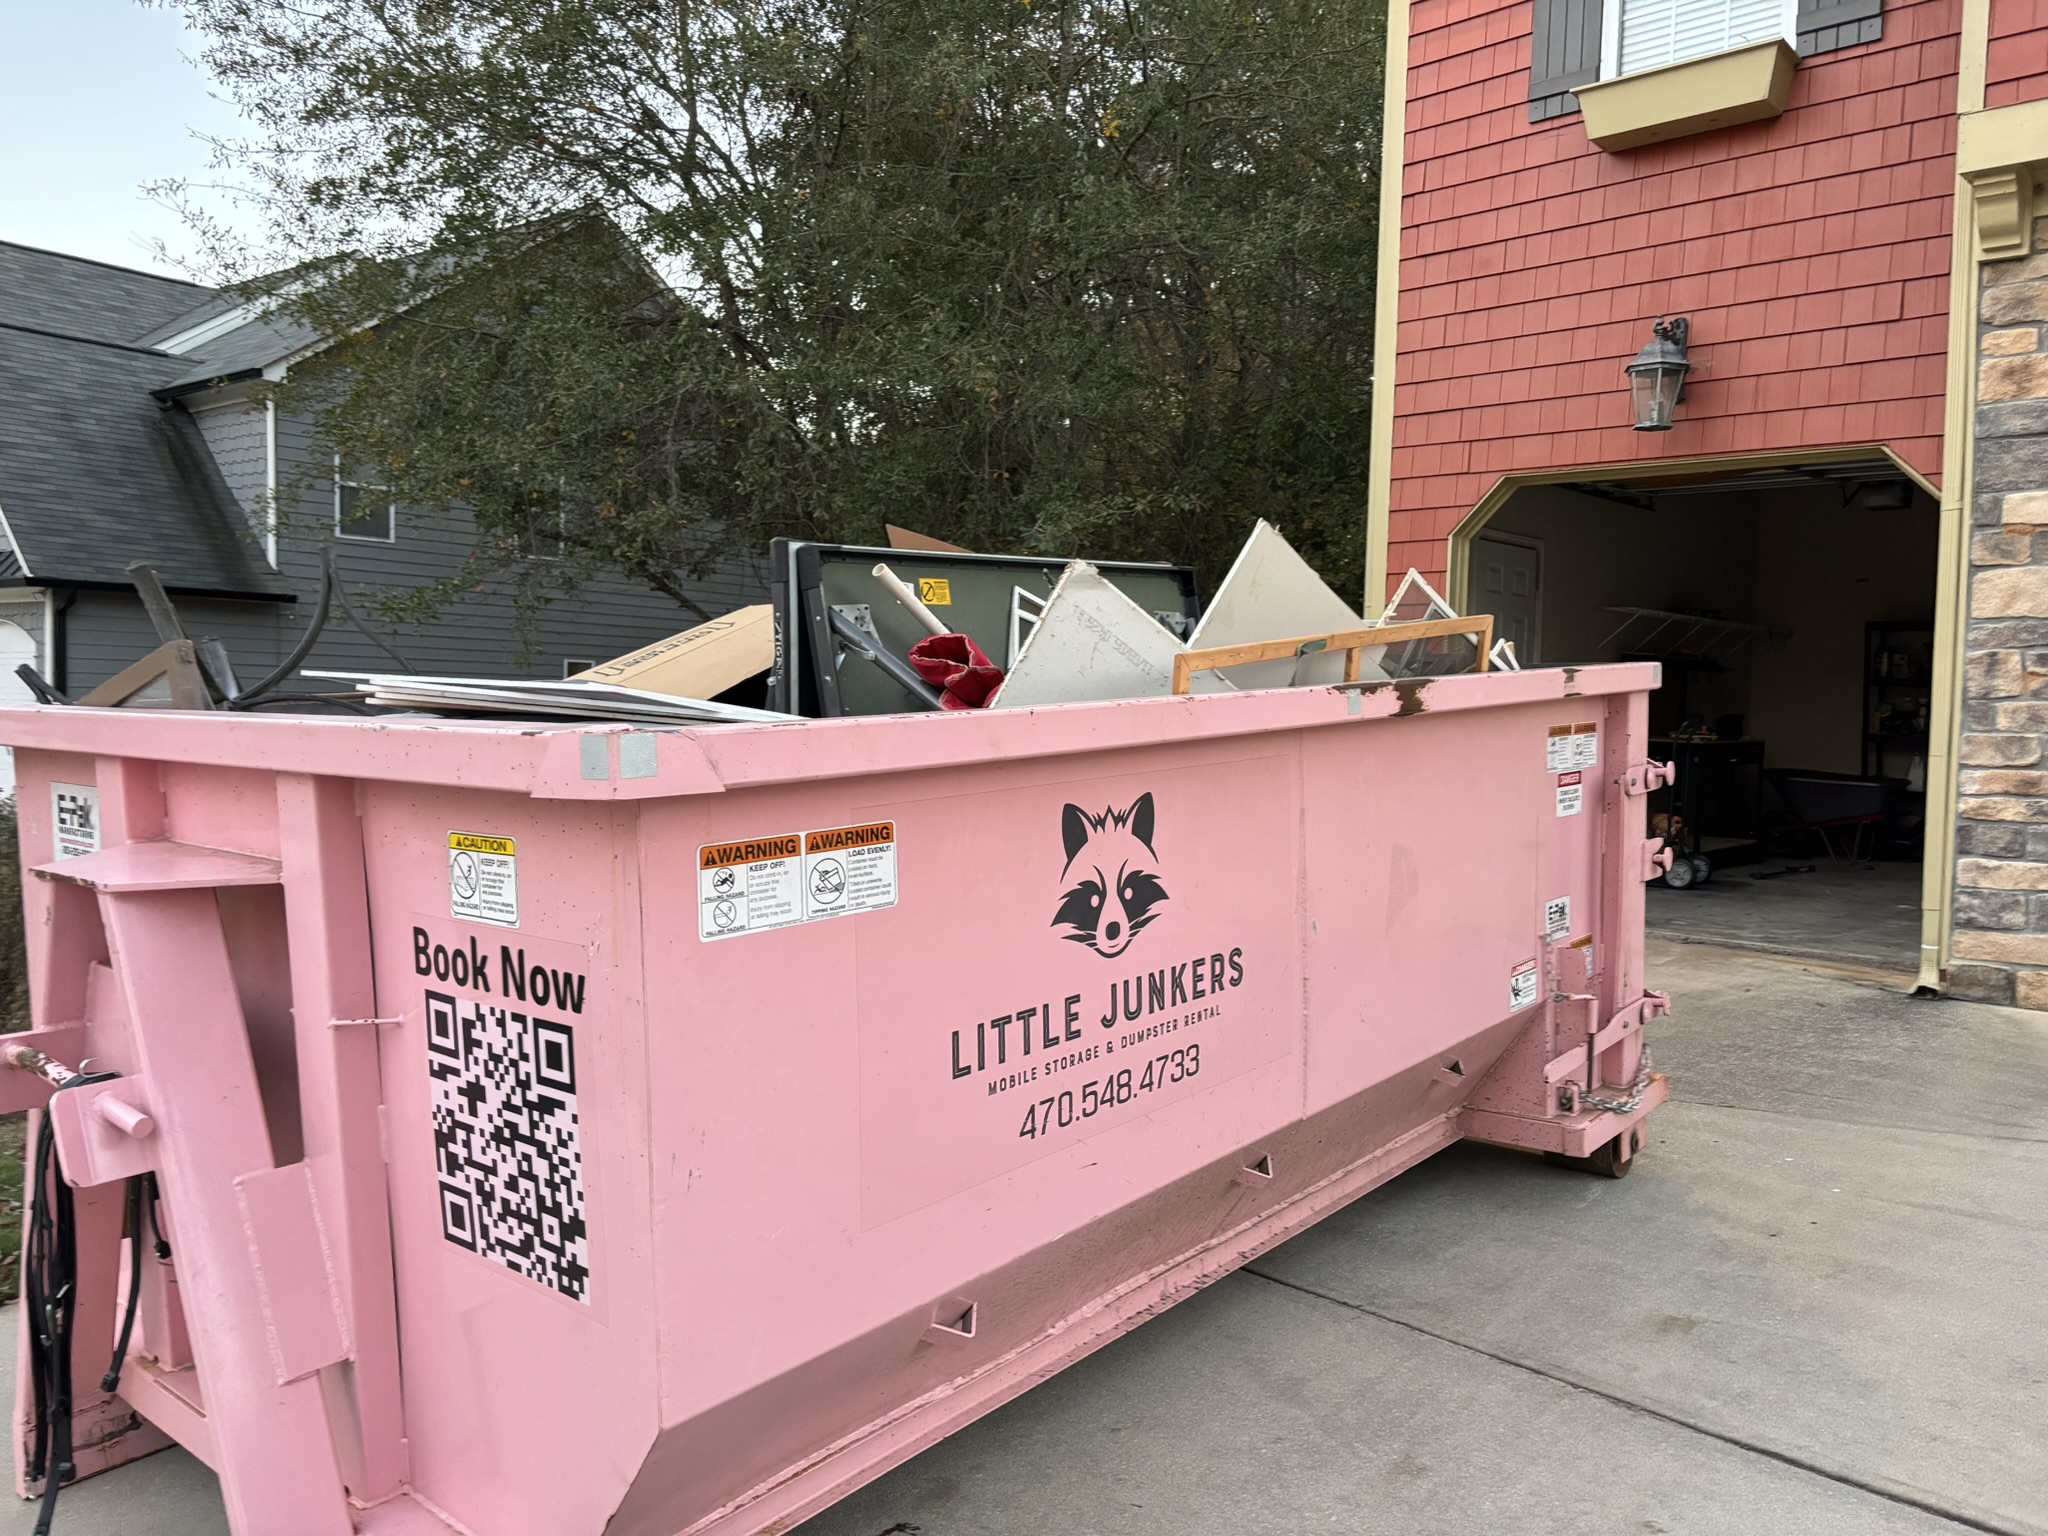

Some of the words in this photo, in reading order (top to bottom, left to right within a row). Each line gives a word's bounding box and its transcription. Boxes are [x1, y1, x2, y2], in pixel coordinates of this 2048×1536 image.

[463, 837, 507, 852] CAUTION
[717, 839, 796, 863] WARNING
[821, 827, 890, 848] WARNING
[848, 849, 865, 857] LOAD
[867, 845, 891, 854] EVENLY!
[413, 926, 490, 992] Book
[501, 945, 586, 1014] Now
[952, 994, 1081, 1079] LITTLE
[1101, 948, 1244, 1028] JUNKERS
[988, 1067, 1037, 1096] MOBILE
[1045, 1045, 1099, 1076] STORAGE
[1106, 1041, 1114, 1054] &
[1121, 1019, 1178, 1049] DUMPSTER
[1184, 1005, 1221, 1027] RENTAL
[1019, 1044, 1200, 1139] 470.548.4733
